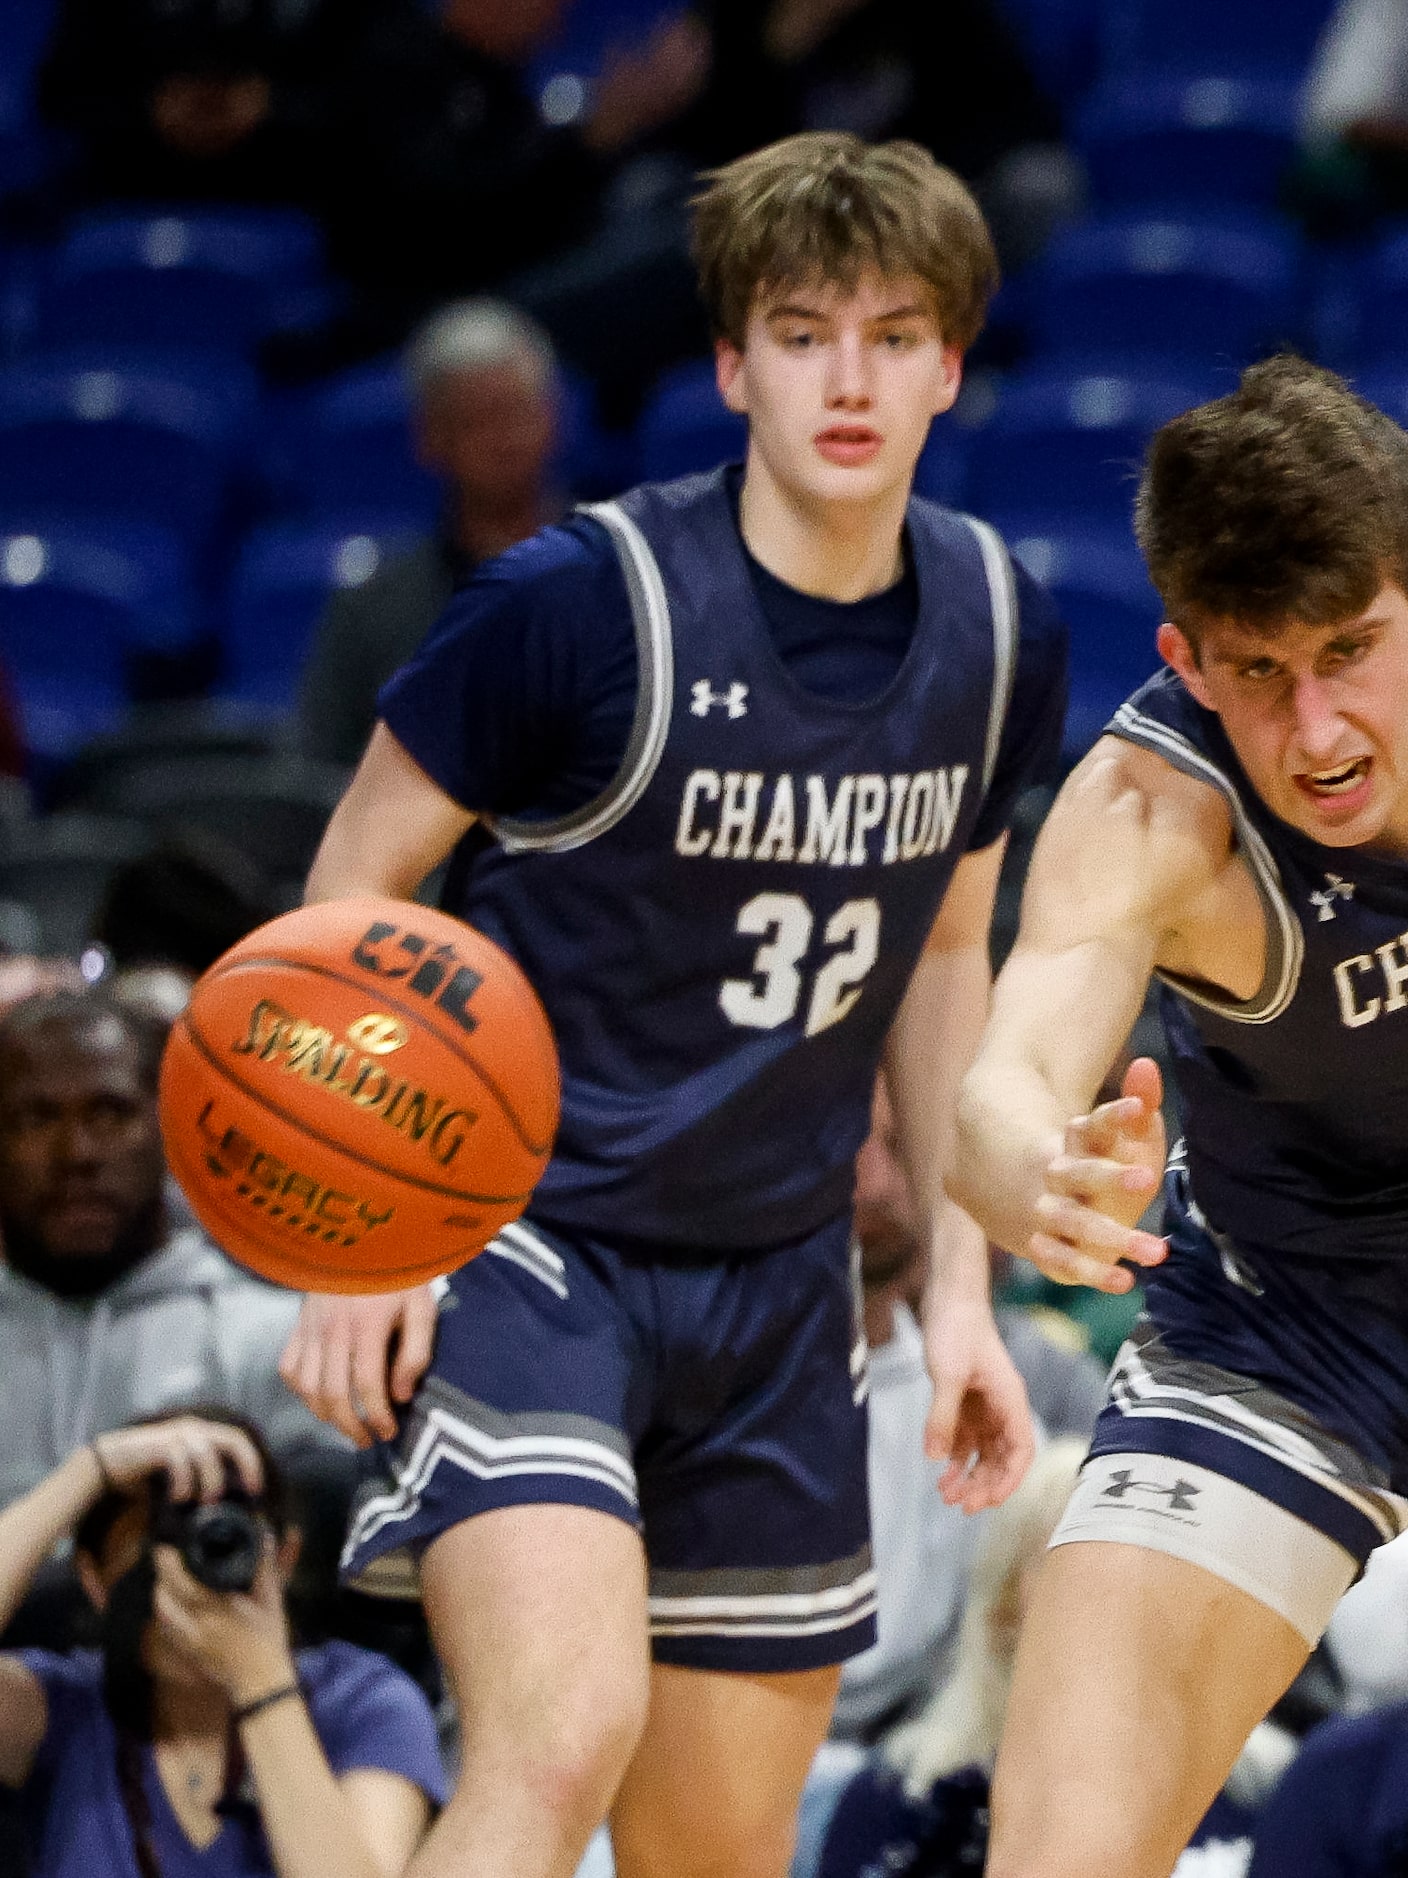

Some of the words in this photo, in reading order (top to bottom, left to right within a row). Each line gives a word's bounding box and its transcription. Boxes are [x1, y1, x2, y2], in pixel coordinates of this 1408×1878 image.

[674, 764, 969, 867] CHAMPION
[718, 891, 882, 1038] 32
[232, 998, 479, 1166] SPALDING
[198, 1099, 395, 1231] LEGACY
